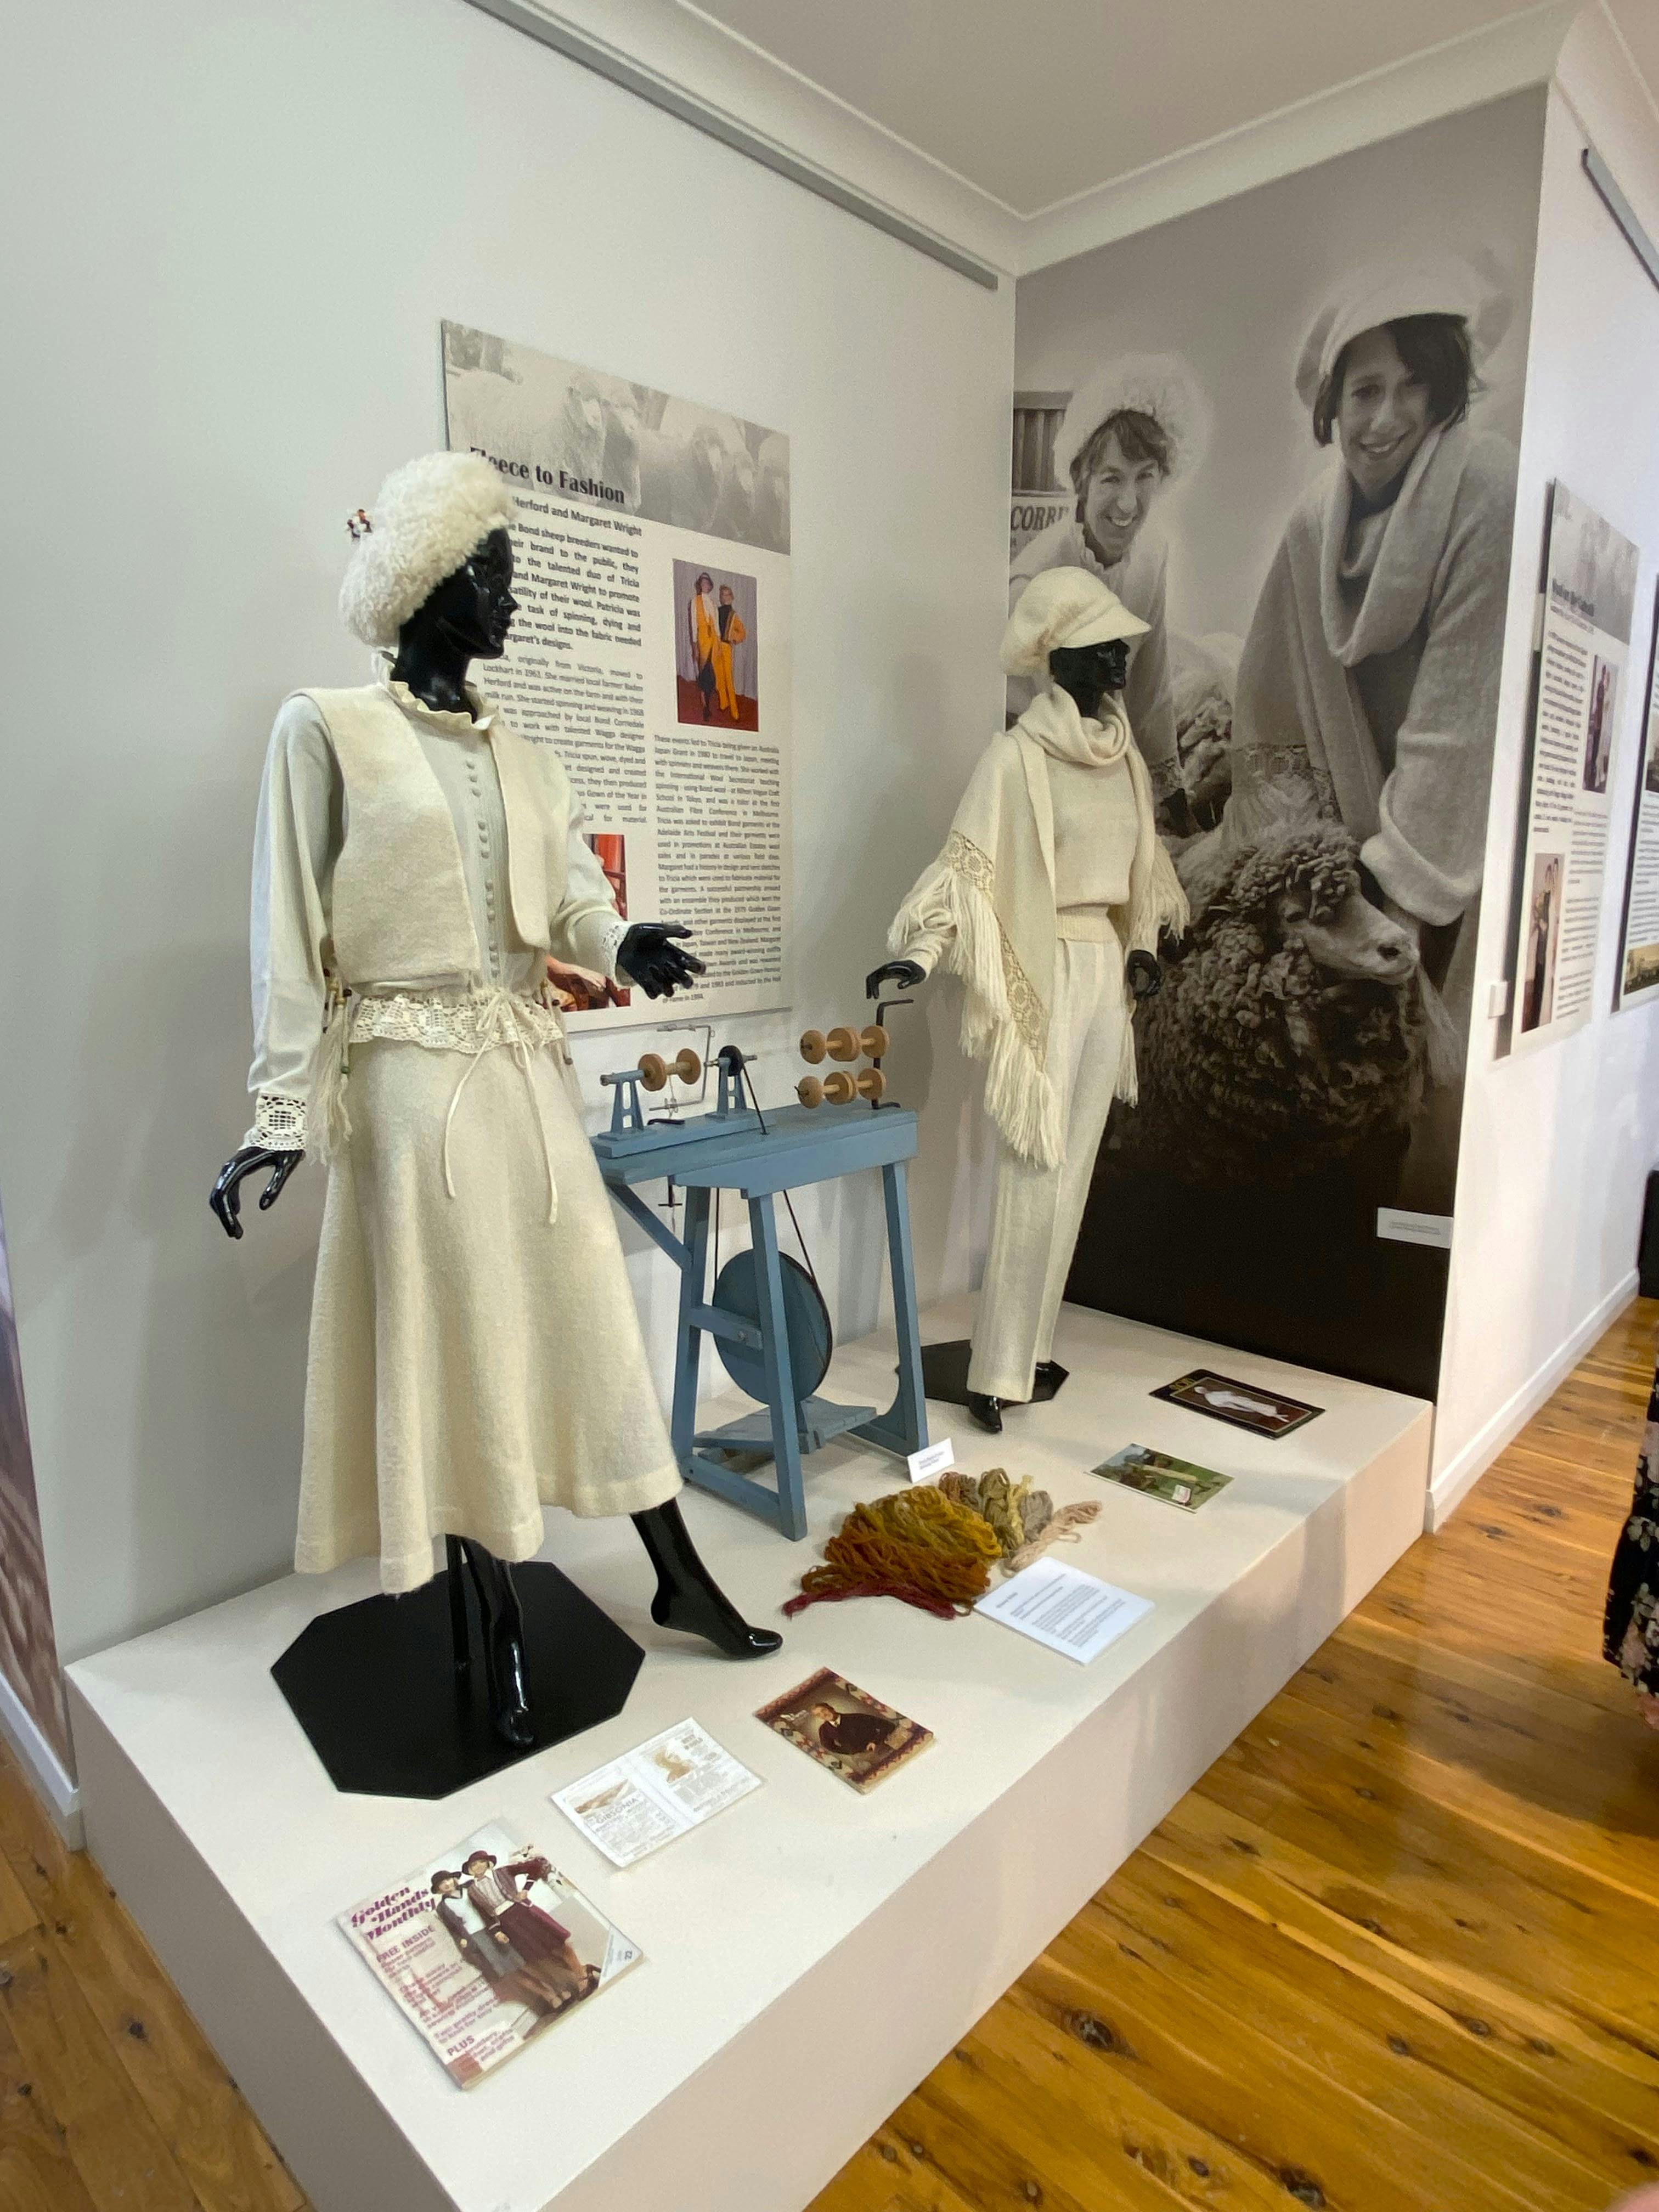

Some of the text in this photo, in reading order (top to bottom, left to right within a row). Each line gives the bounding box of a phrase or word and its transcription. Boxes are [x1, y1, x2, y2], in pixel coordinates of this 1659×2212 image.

[470, 447, 625, 504] eece to Fashion
[551, 508, 568, 517] and
[571, 510, 611, 528] Margaret
[613, 521, 641, 535] Wright
[518, 523, 539, 535] Bond
[541, 529, 565, 541] sheep
[567, 535, 600, 549] breeders
[602, 544, 629, 555] wanted
[531, 541, 553, 554] brand
[574, 552, 586, 561] the
[593, 557, 617, 568] public,
[623, 563, 638, 573] they
[527, 558, 540, 567] the
[548, 562, 580, 574] talented
[587, 570, 601, 579] duo
[620, 577, 639, 587] Tricia
[532, 573, 567, 588] Margaret
[571, 582, 595, 593] Wright
[609, 591, 639, 602] promote
[528, 605, 544, 613] task
[563, 612, 597, 625] spinning,
[603, 618, 622, 629] dying
[551, 593, 569, 602] their
[573, 599, 592, 607] wool.
[597, 602, 623, 613] Patricia
[518, 618, 531, 627] the
[558, 624, 573, 634] into
[575, 628, 588, 636] the
[592, 630, 612, 641] fabric
[616, 636, 641, 646] needed
[483, 664, 513, 674] Lockhart
[588, 777, 601, 786] they
[351, 1887, 410, 1927] Golden
[367, 1898, 437, 1940] Monthly
[371, 1889, 428, 1922] Hands
[377, 1945, 400, 1962] FREE
[402, 1925, 435, 1948] INSIDE
[447, 2035, 475, 2056] PLUS
